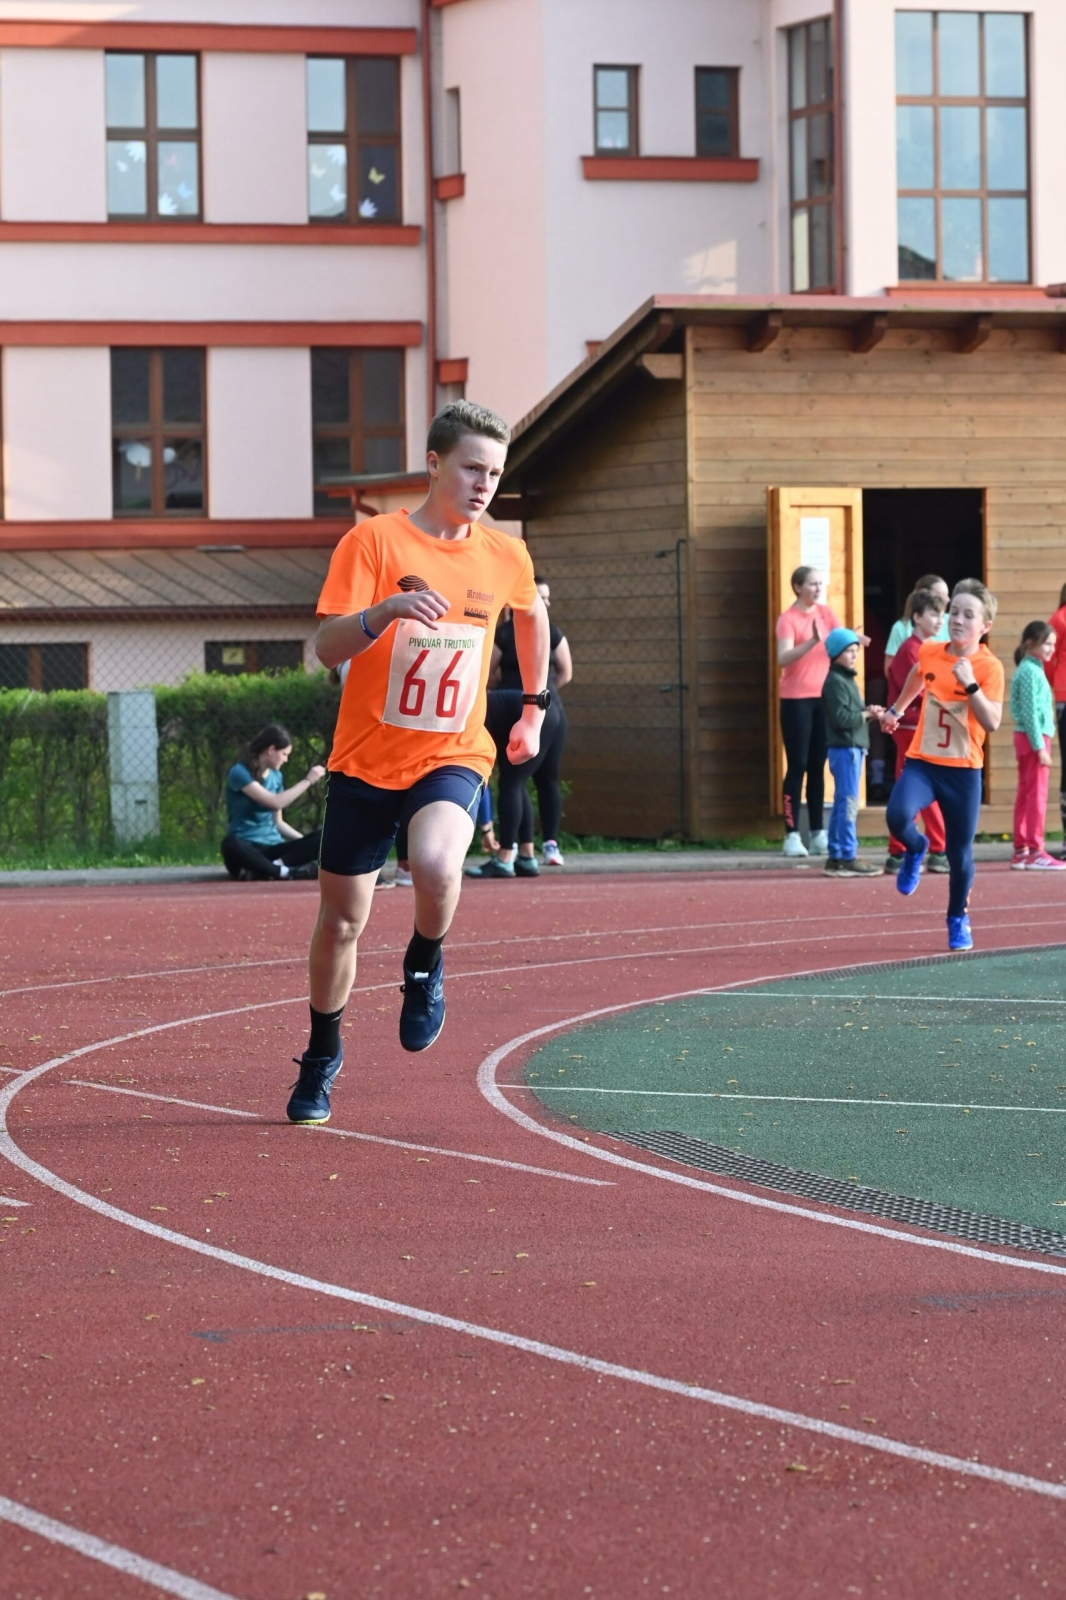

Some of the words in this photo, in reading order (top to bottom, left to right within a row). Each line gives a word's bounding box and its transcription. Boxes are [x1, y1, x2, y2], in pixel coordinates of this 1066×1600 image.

[409, 637, 441, 648] PIVOVAR
[444, 638, 475, 649] TRUTNOV
[399, 649, 464, 718] 66
[937, 709, 951, 748] 5
